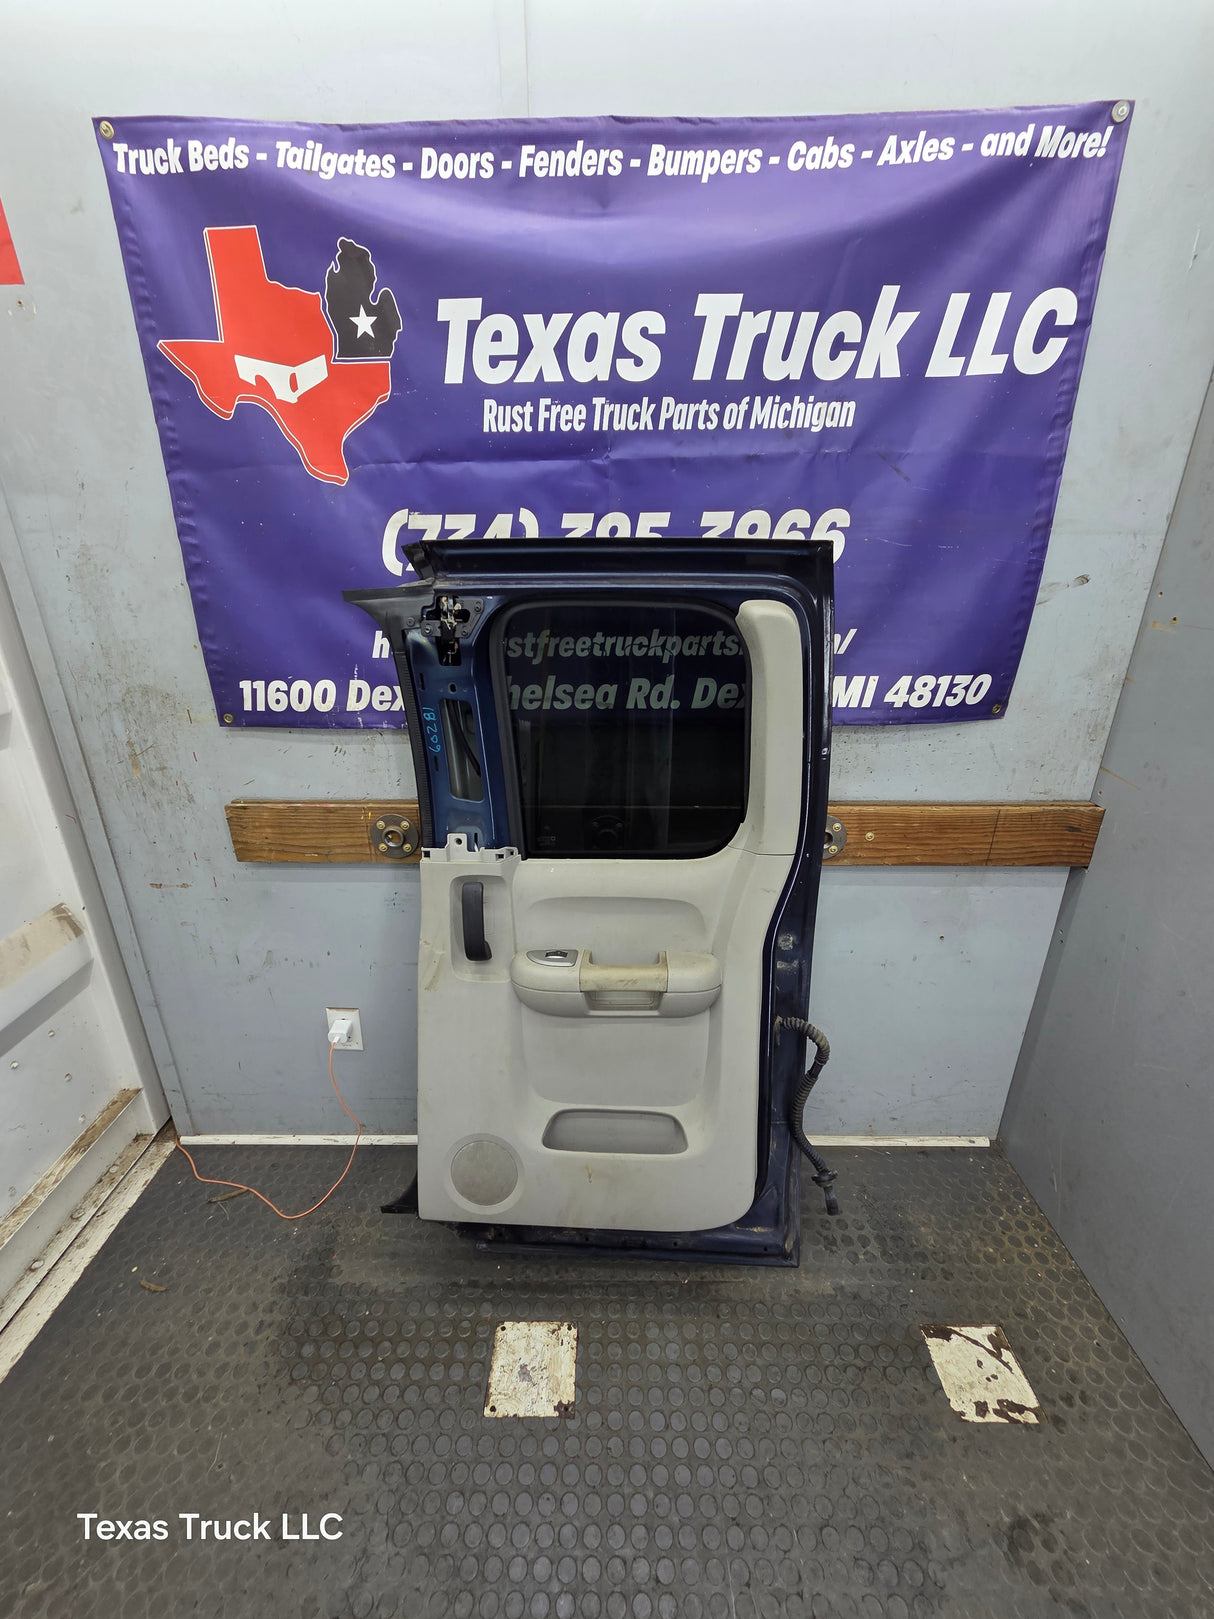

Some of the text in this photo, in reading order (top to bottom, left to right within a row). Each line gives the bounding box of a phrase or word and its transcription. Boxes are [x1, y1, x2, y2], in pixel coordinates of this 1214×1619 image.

[112, 138, 184, 175] Truck
[188, 137, 250, 172] Beds
[275, 140, 396, 180] Tailgates
[420, 147, 495, 180] Doors
[519, 140, 624, 178] Fenders
[647, 144, 763, 183] Bumpers
[787, 136, 855, 172] Cabs
[876, 130, 955, 166] Axles
[980, 124, 1036, 157] and
[1034, 124, 1114, 160] More!
[437, 285, 1079, 384] Texas Truck LLC
[483, 395, 857, 433] Rust Free Truck Parts of Michigan
[239, 679, 337, 712] 11600
[346, 678, 406, 712] Dex
[508, 675, 618, 710] helsea
[626, 674, 681, 710] Rd.
[832, 675, 880, 708] MI
[883, 673, 992, 708] 48130
